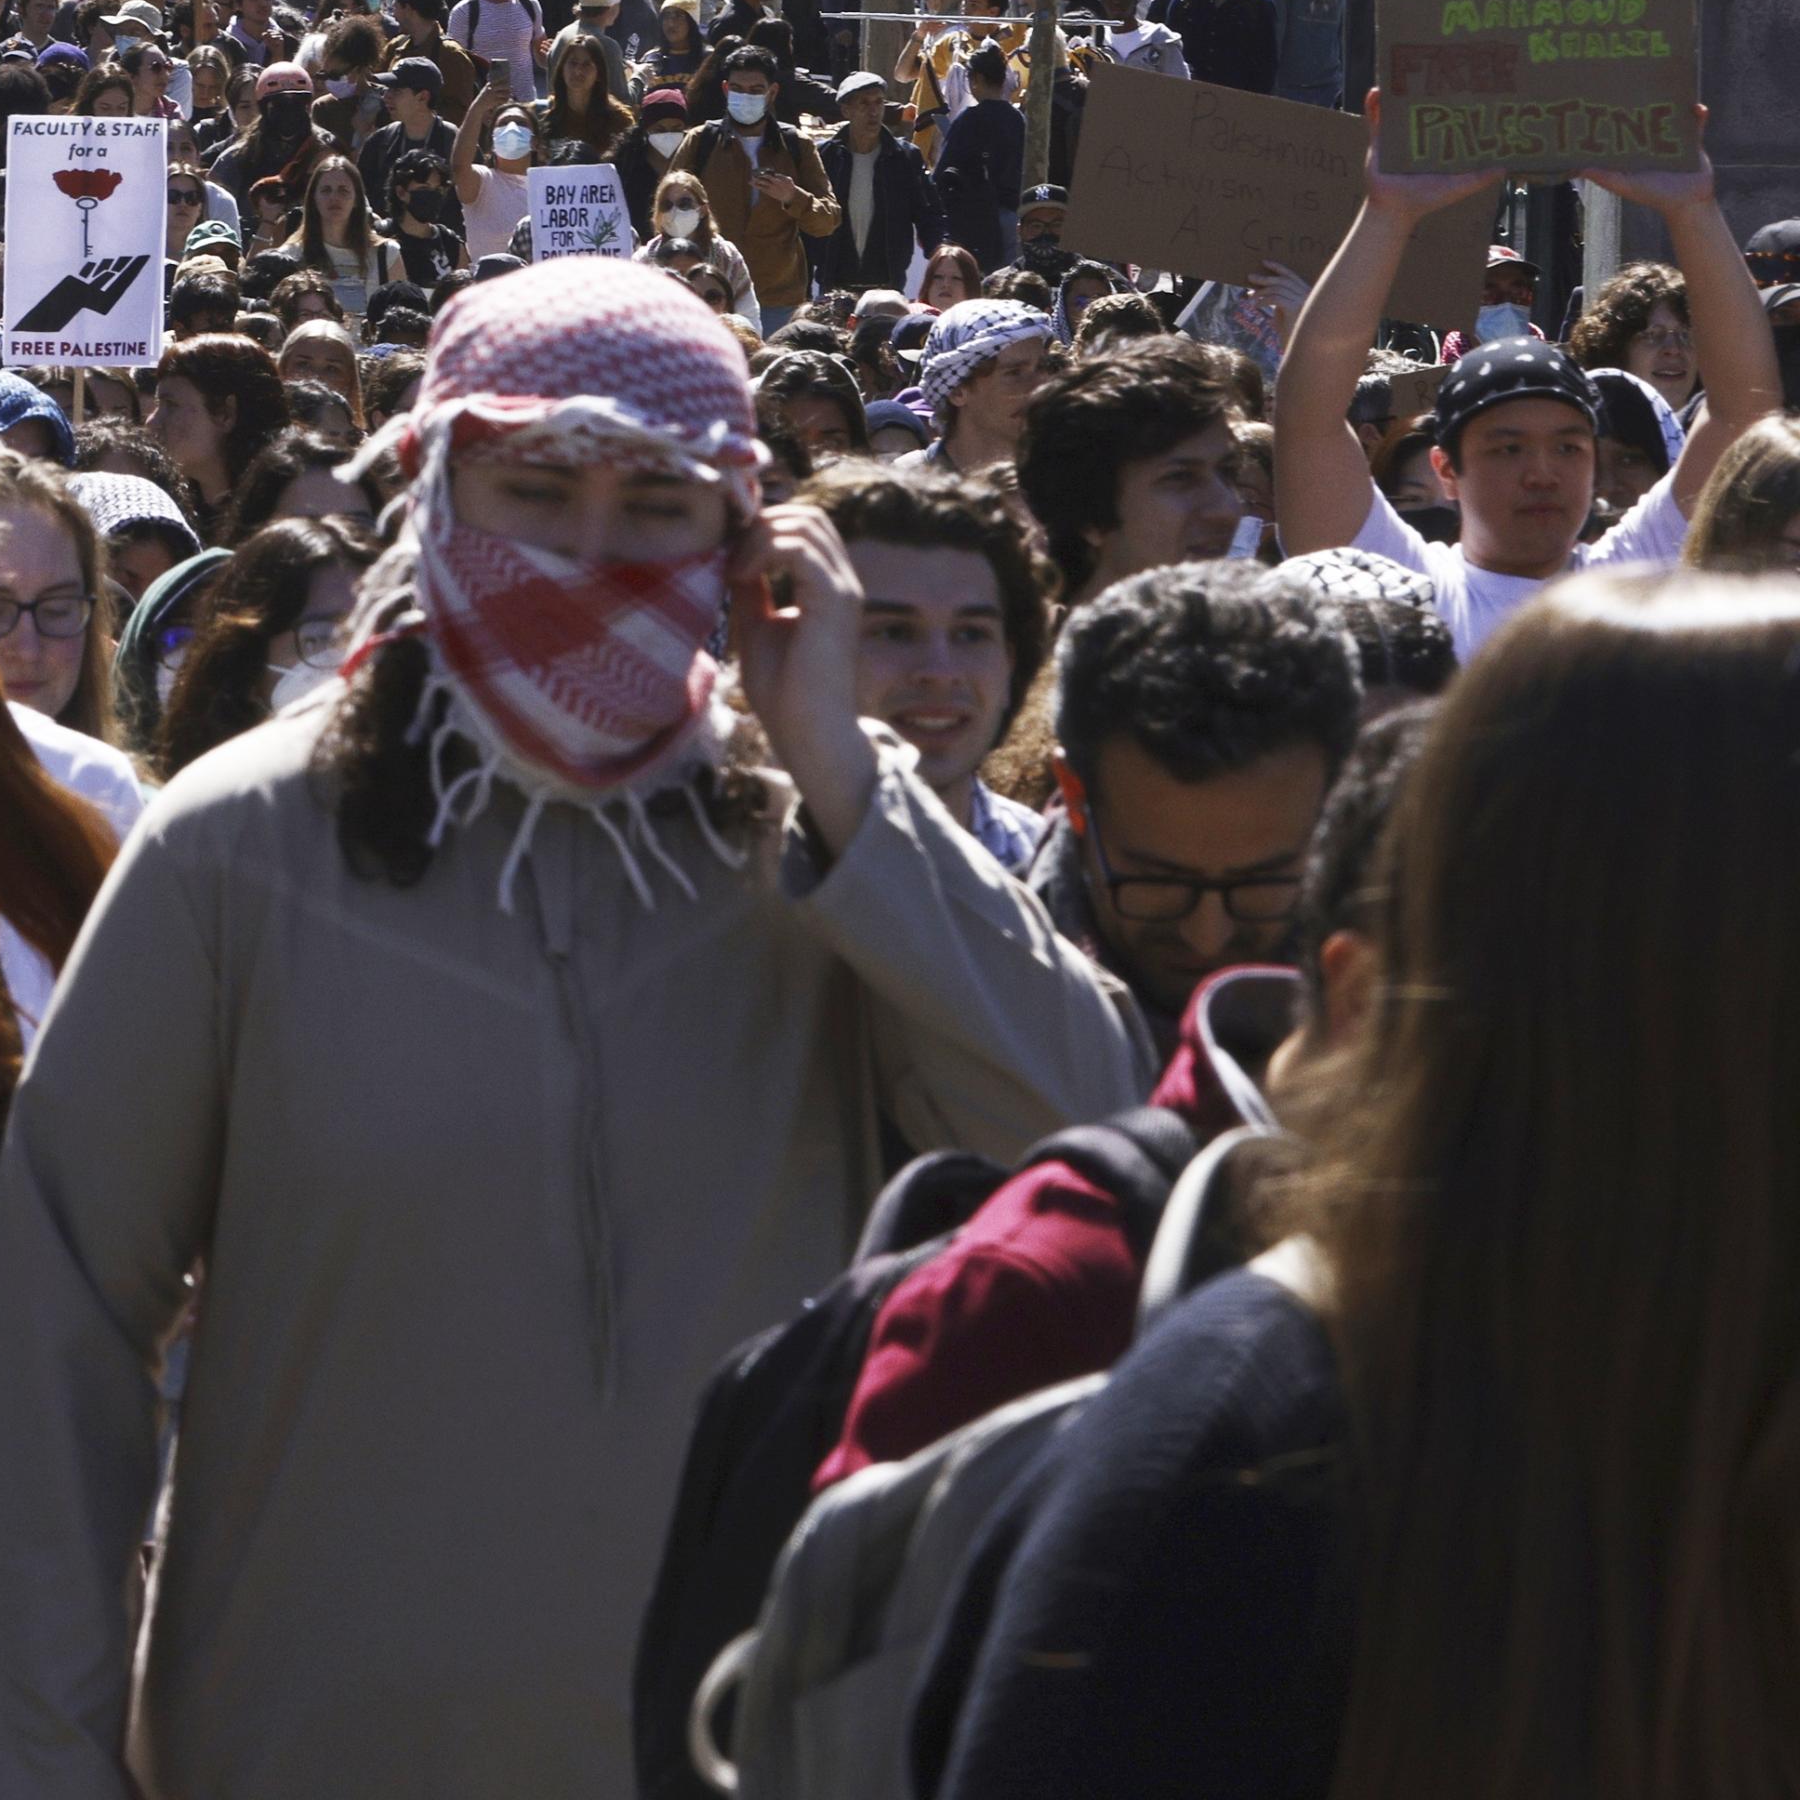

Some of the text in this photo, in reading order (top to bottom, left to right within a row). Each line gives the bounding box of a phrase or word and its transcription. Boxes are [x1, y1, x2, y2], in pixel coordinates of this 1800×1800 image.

[1527, 29, 1671, 63] KHALIL
[1390, 44, 1519, 97] FREE
[13, 122, 160, 137] FACULTY & STAFF
[1410, 100, 1683, 162] PALESTINE
[68, 143, 107, 160] for a
[1097, 144, 1265, 201] Activism
[546, 184, 616, 205] BAY AREA
[541, 207, 589, 228] LABOR
[1169, 204, 1201, 246] A
[551, 231, 575, 247] FOR
[11, 341, 147, 357] FREE PALESTINE
